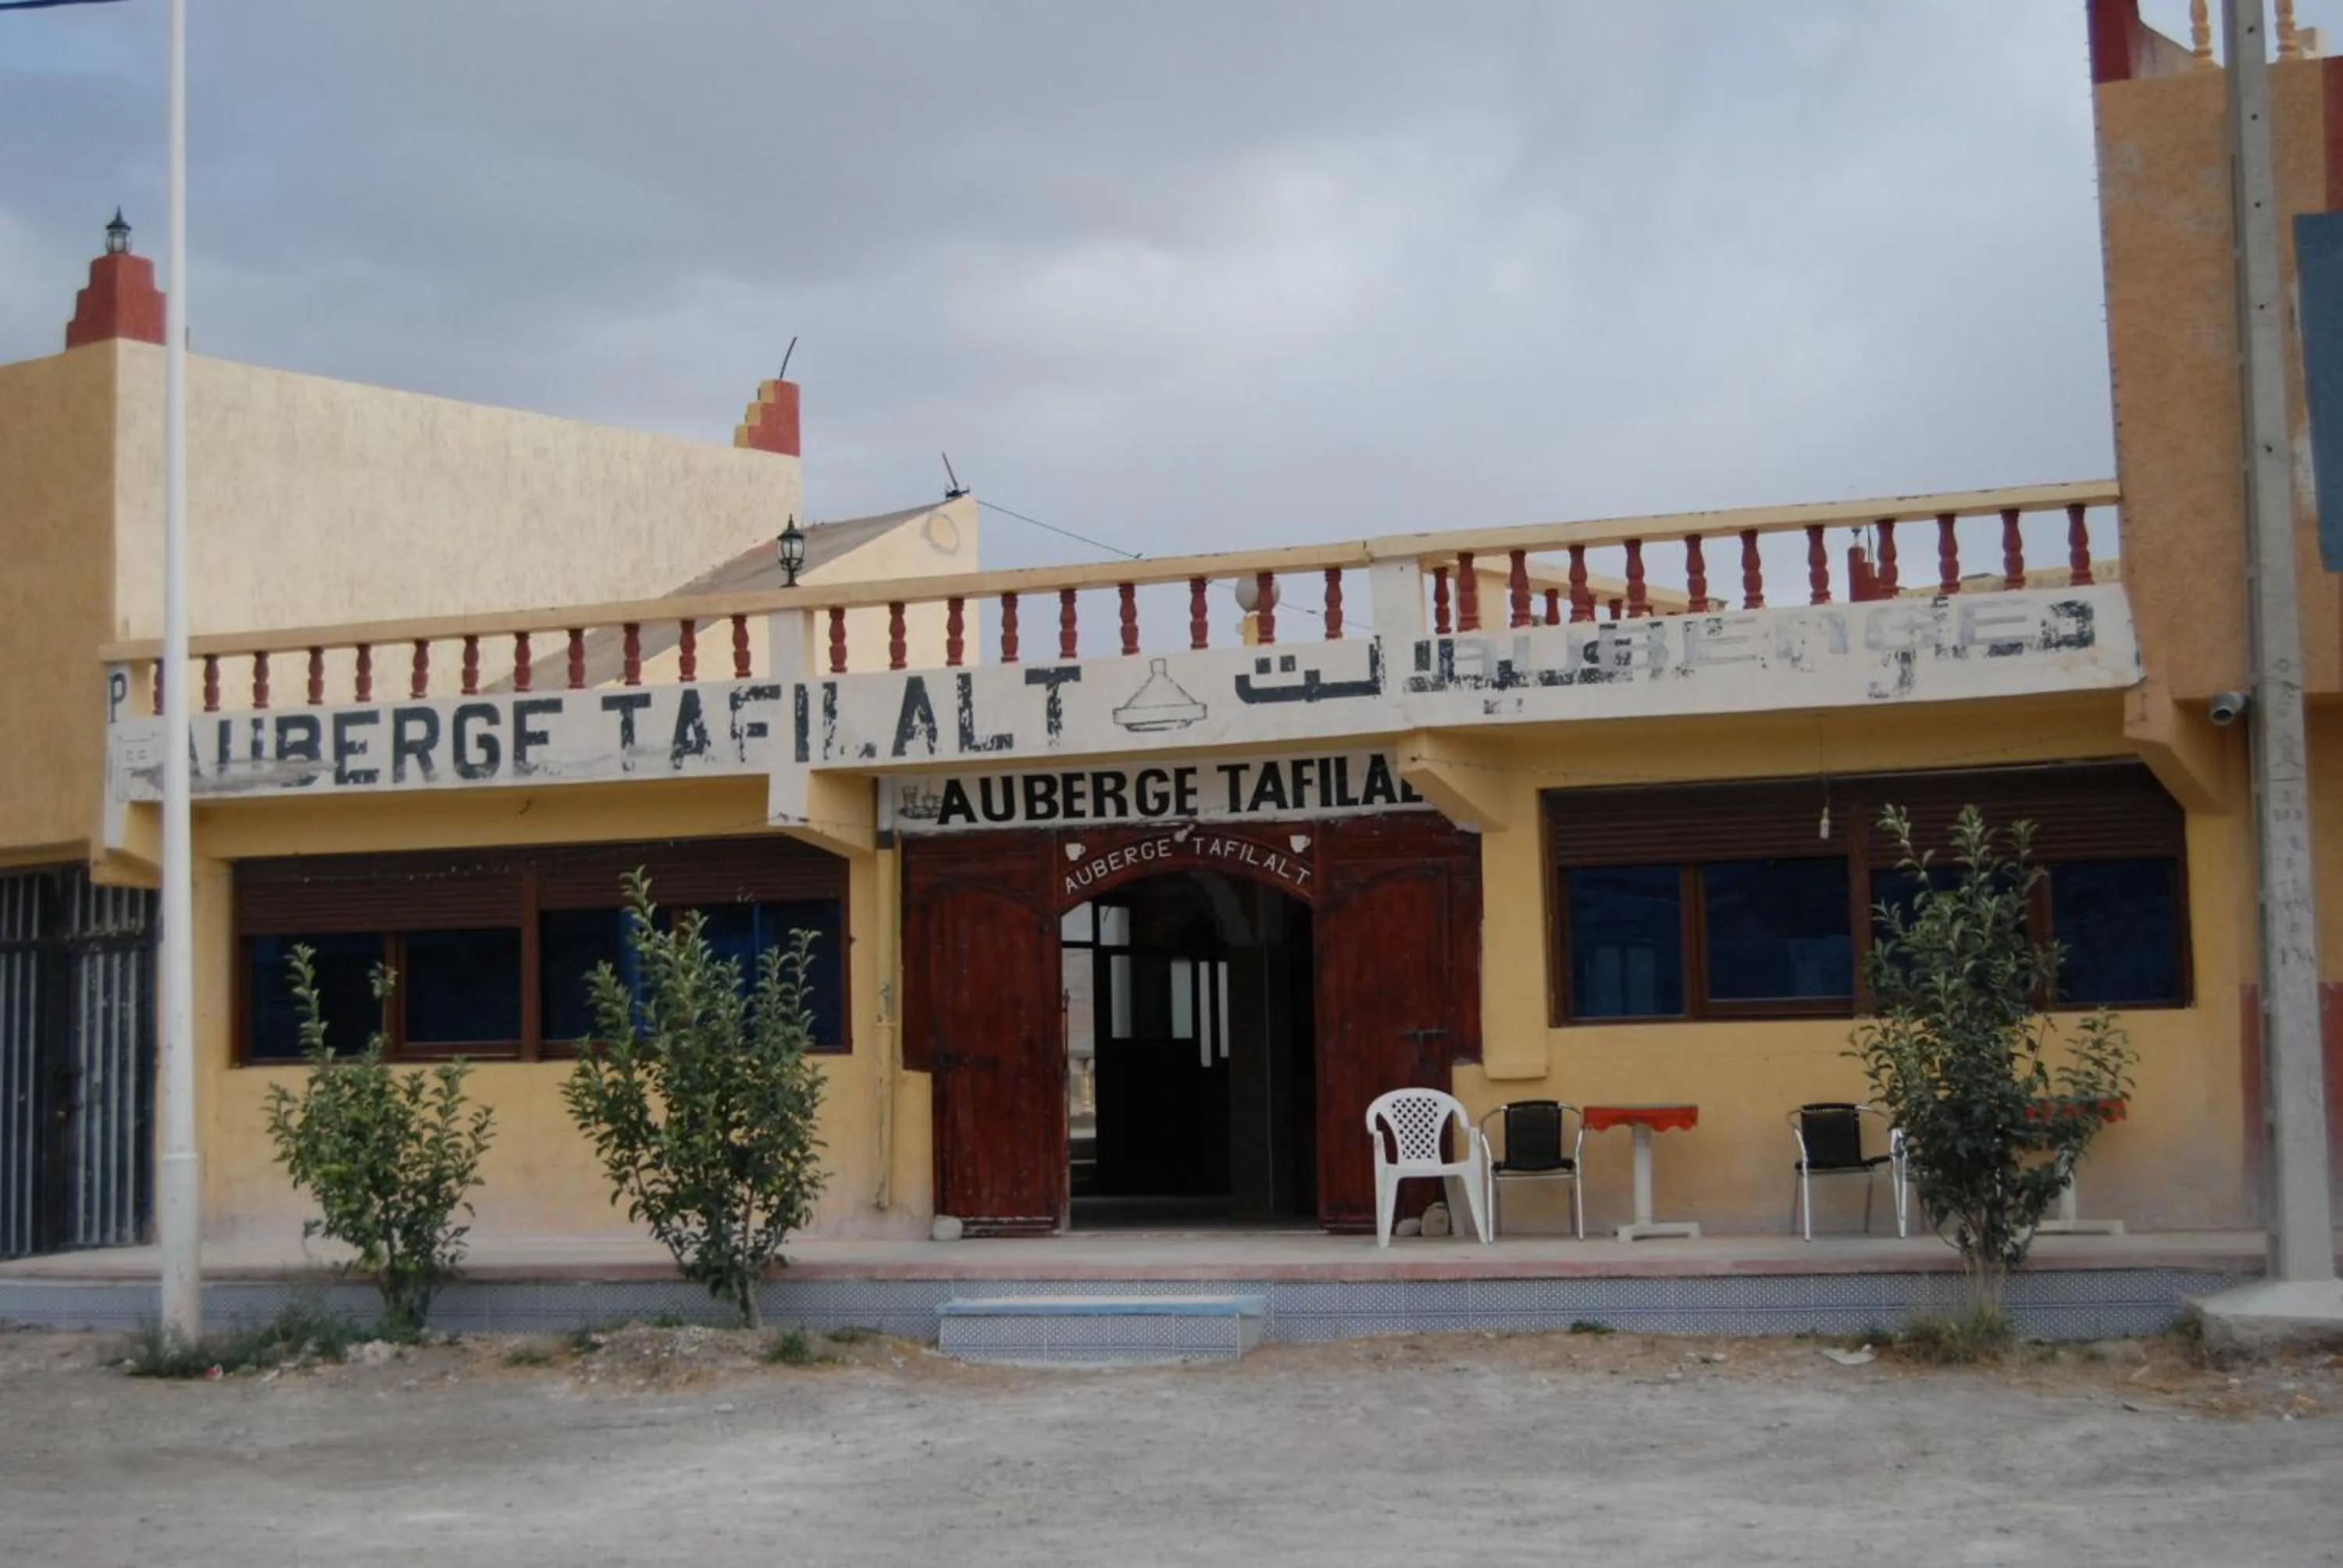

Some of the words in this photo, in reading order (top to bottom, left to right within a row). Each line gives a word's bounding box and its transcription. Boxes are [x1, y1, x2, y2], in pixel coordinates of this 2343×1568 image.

[601, 665, 1081, 772] TAFILALT
[937, 766, 1198, 825] AUBERGE
[1065, 838, 1172, 894] AUBERGE
[1192, 837, 1311, 885] TAFILALT
